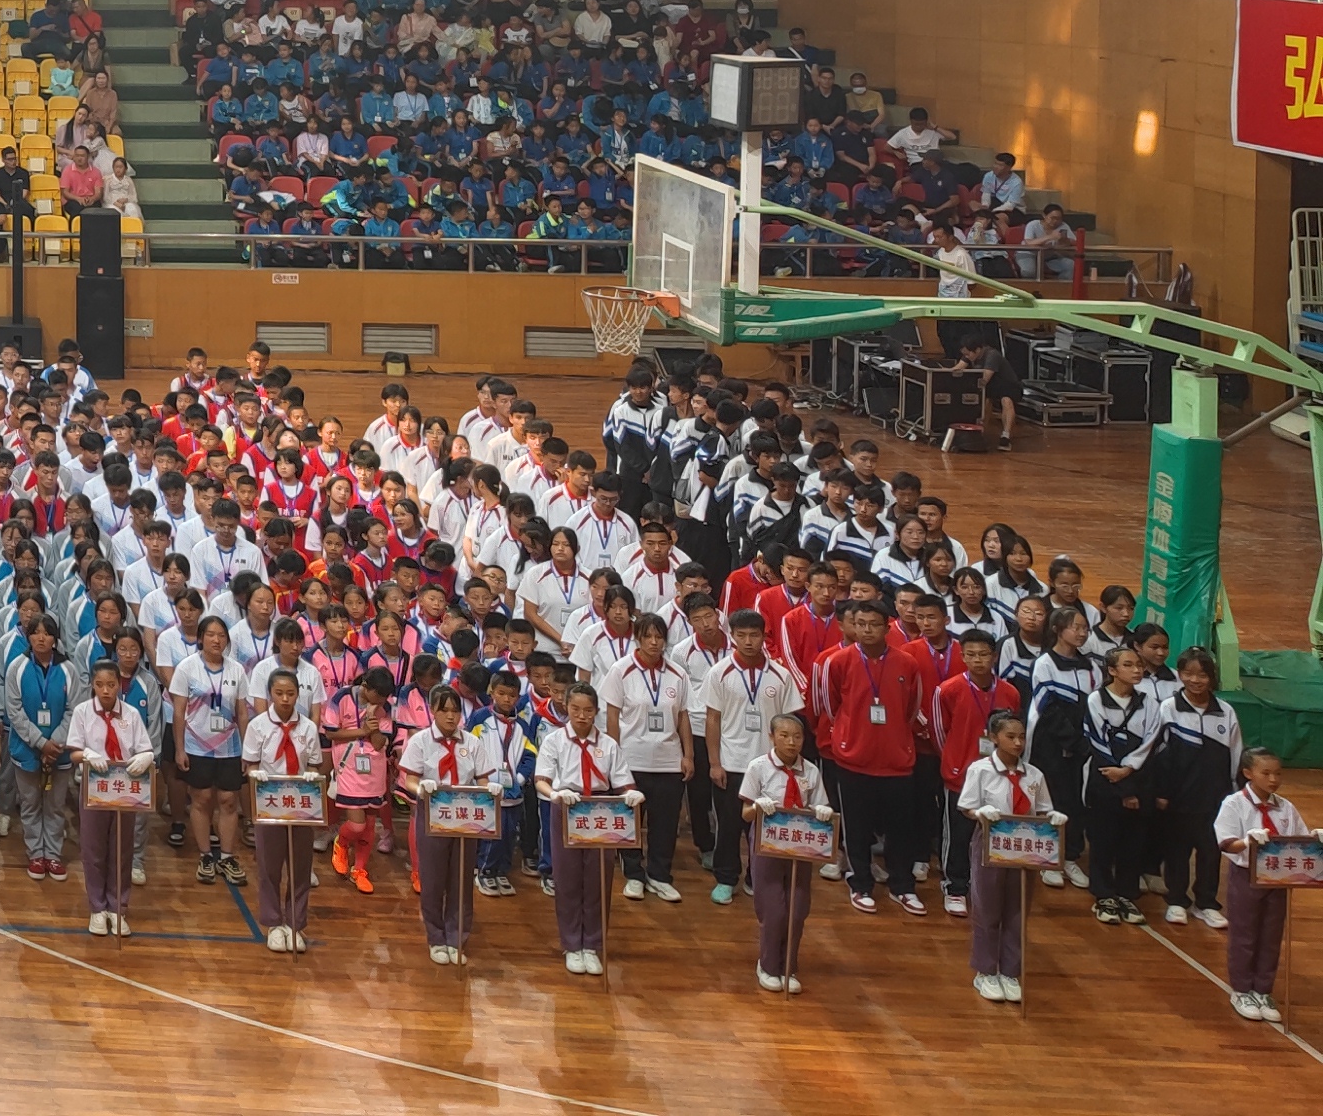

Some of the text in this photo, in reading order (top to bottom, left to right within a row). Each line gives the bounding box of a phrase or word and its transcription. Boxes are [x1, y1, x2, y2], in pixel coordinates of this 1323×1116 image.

[96, 780, 142, 794] 南华县
[265, 794, 313, 809] 大姚县
[438, 806, 487, 821] 元谋县
[575, 816, 627, 830] 武定县
[765, 826, 829, 847] 州民族中学
[992, 836, 1055, 854] 楚雄福泉中学
[1265, 856, 1316, 871] 禄丰市
